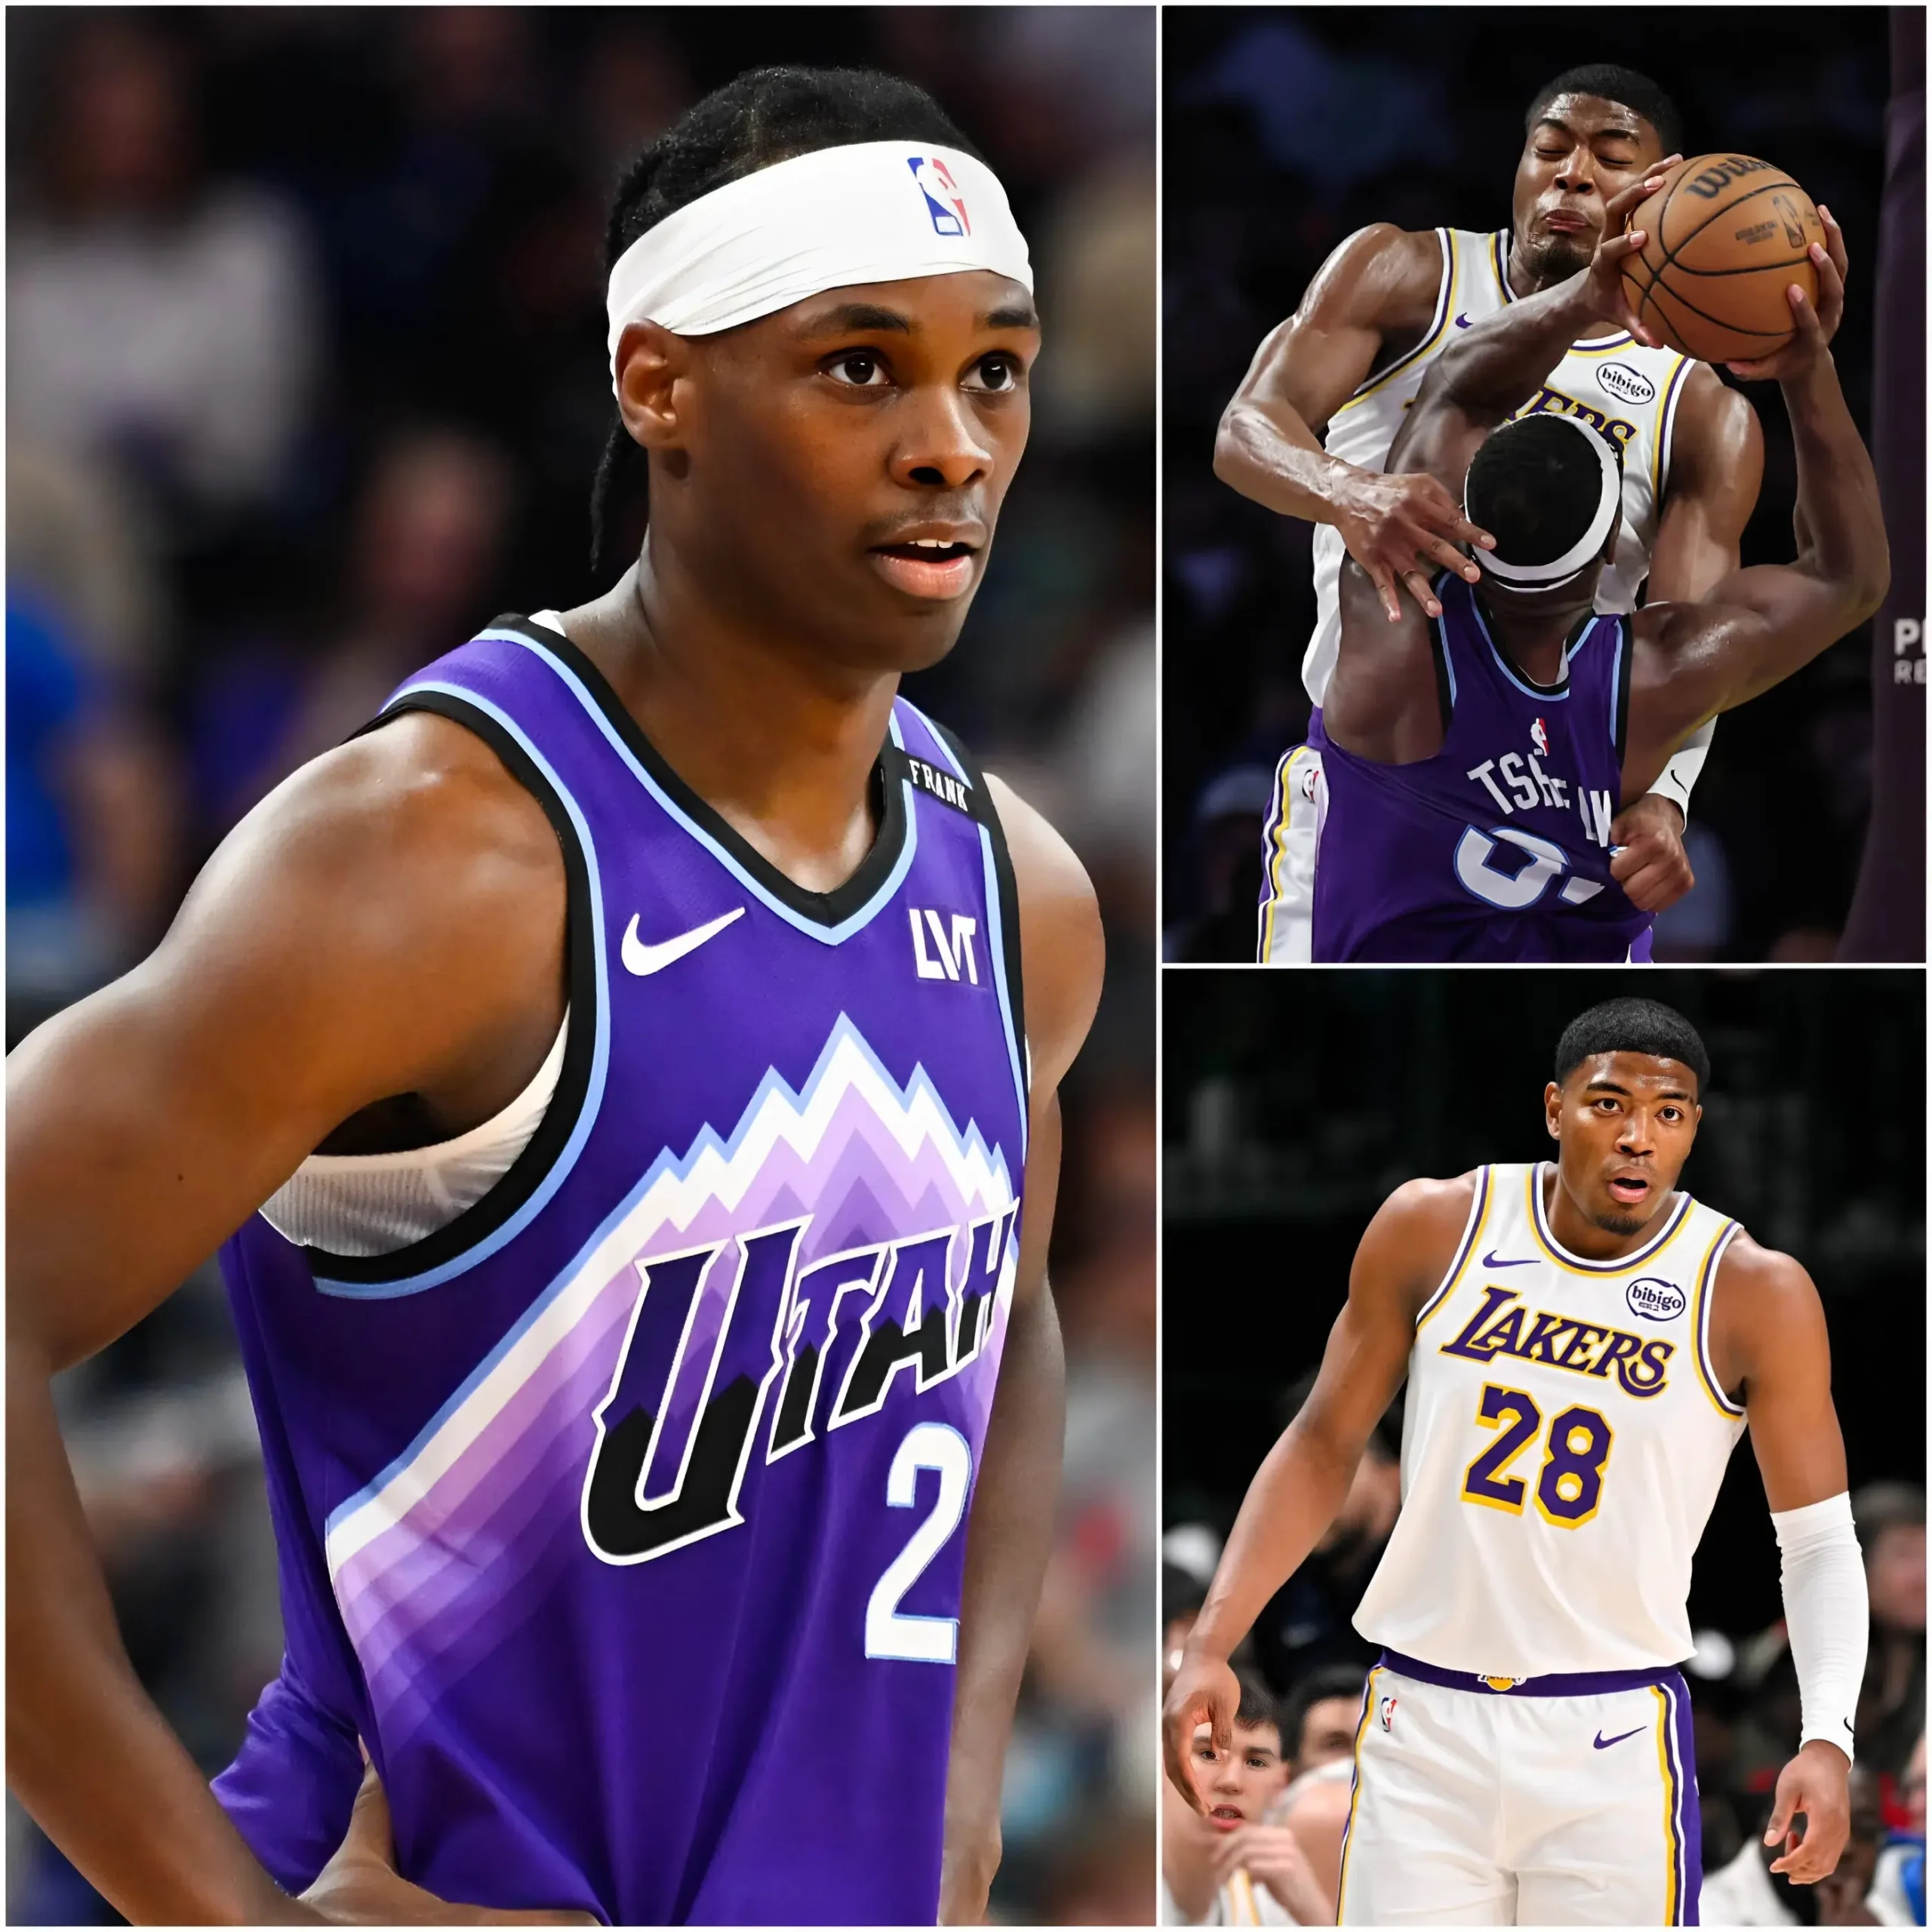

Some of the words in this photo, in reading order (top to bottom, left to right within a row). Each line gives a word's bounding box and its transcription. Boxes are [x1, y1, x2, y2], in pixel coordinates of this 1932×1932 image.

[1602, 368, 1651, 397] bibigo
[1894, 617, 1927, 656] P
[909, 759, 968, 812] FRANK
[1632, 1284, 1682, 1312] bibigo
[580, 1196, 1020, 1566] UTAH
[1438, 1284, 1678, 1401] LAKERS
[1460, 1381, 1615, 1531] 28
[864, 1421, 972, 1664] 2
